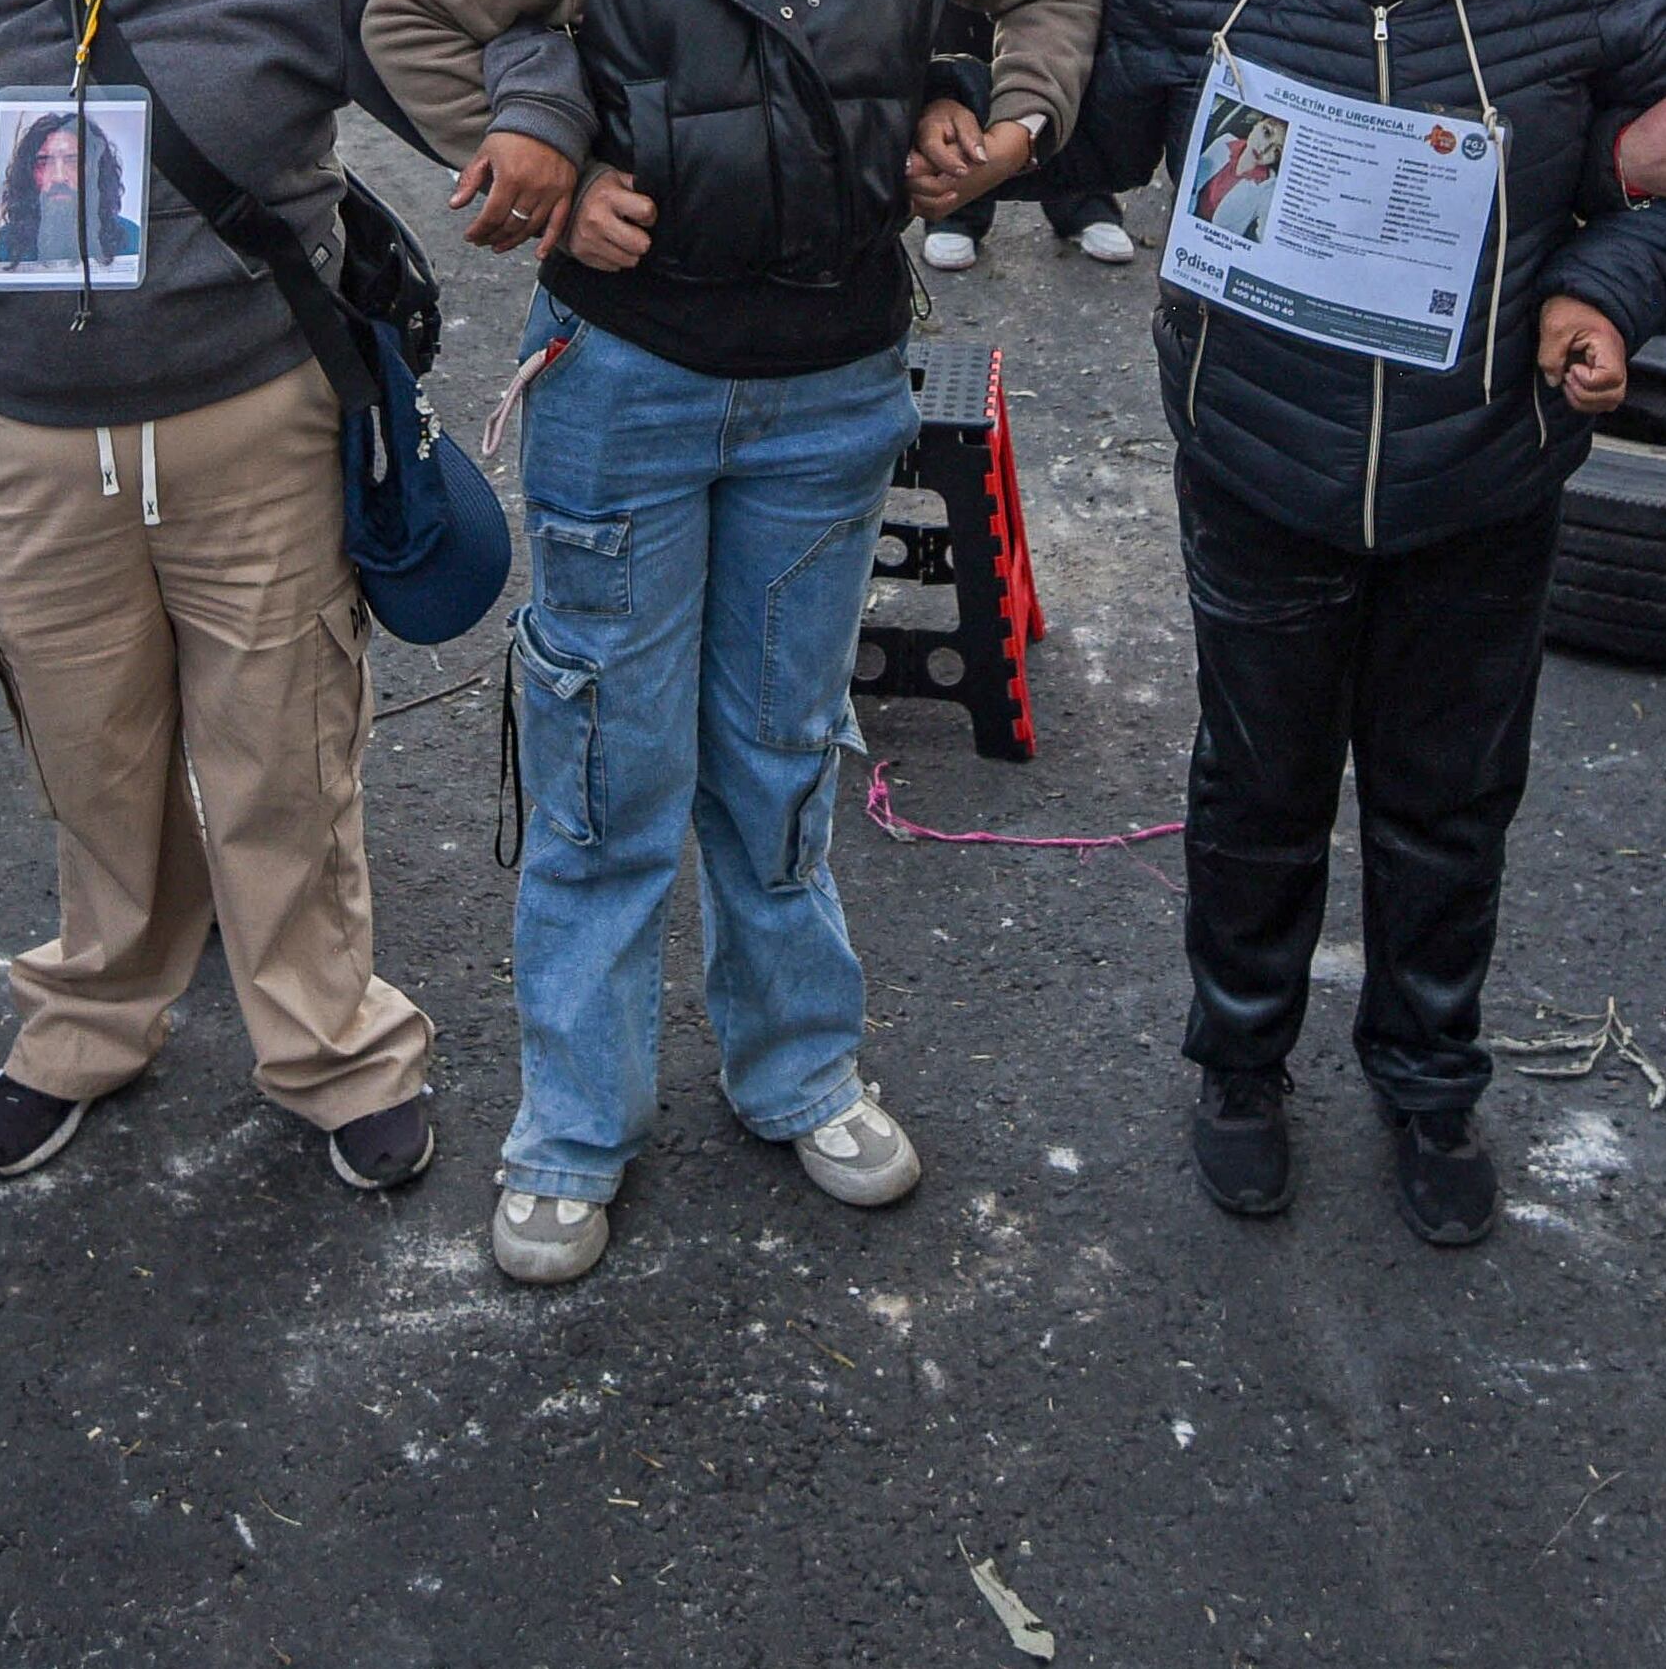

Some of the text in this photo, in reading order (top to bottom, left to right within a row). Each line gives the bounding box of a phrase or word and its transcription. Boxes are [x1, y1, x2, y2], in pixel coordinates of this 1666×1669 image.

[1282, 89, 1325, 112] BOLETÍN
[1327, 105, 1344, 118] DE
[1345, 109, 1404, 131] URGENCIA
